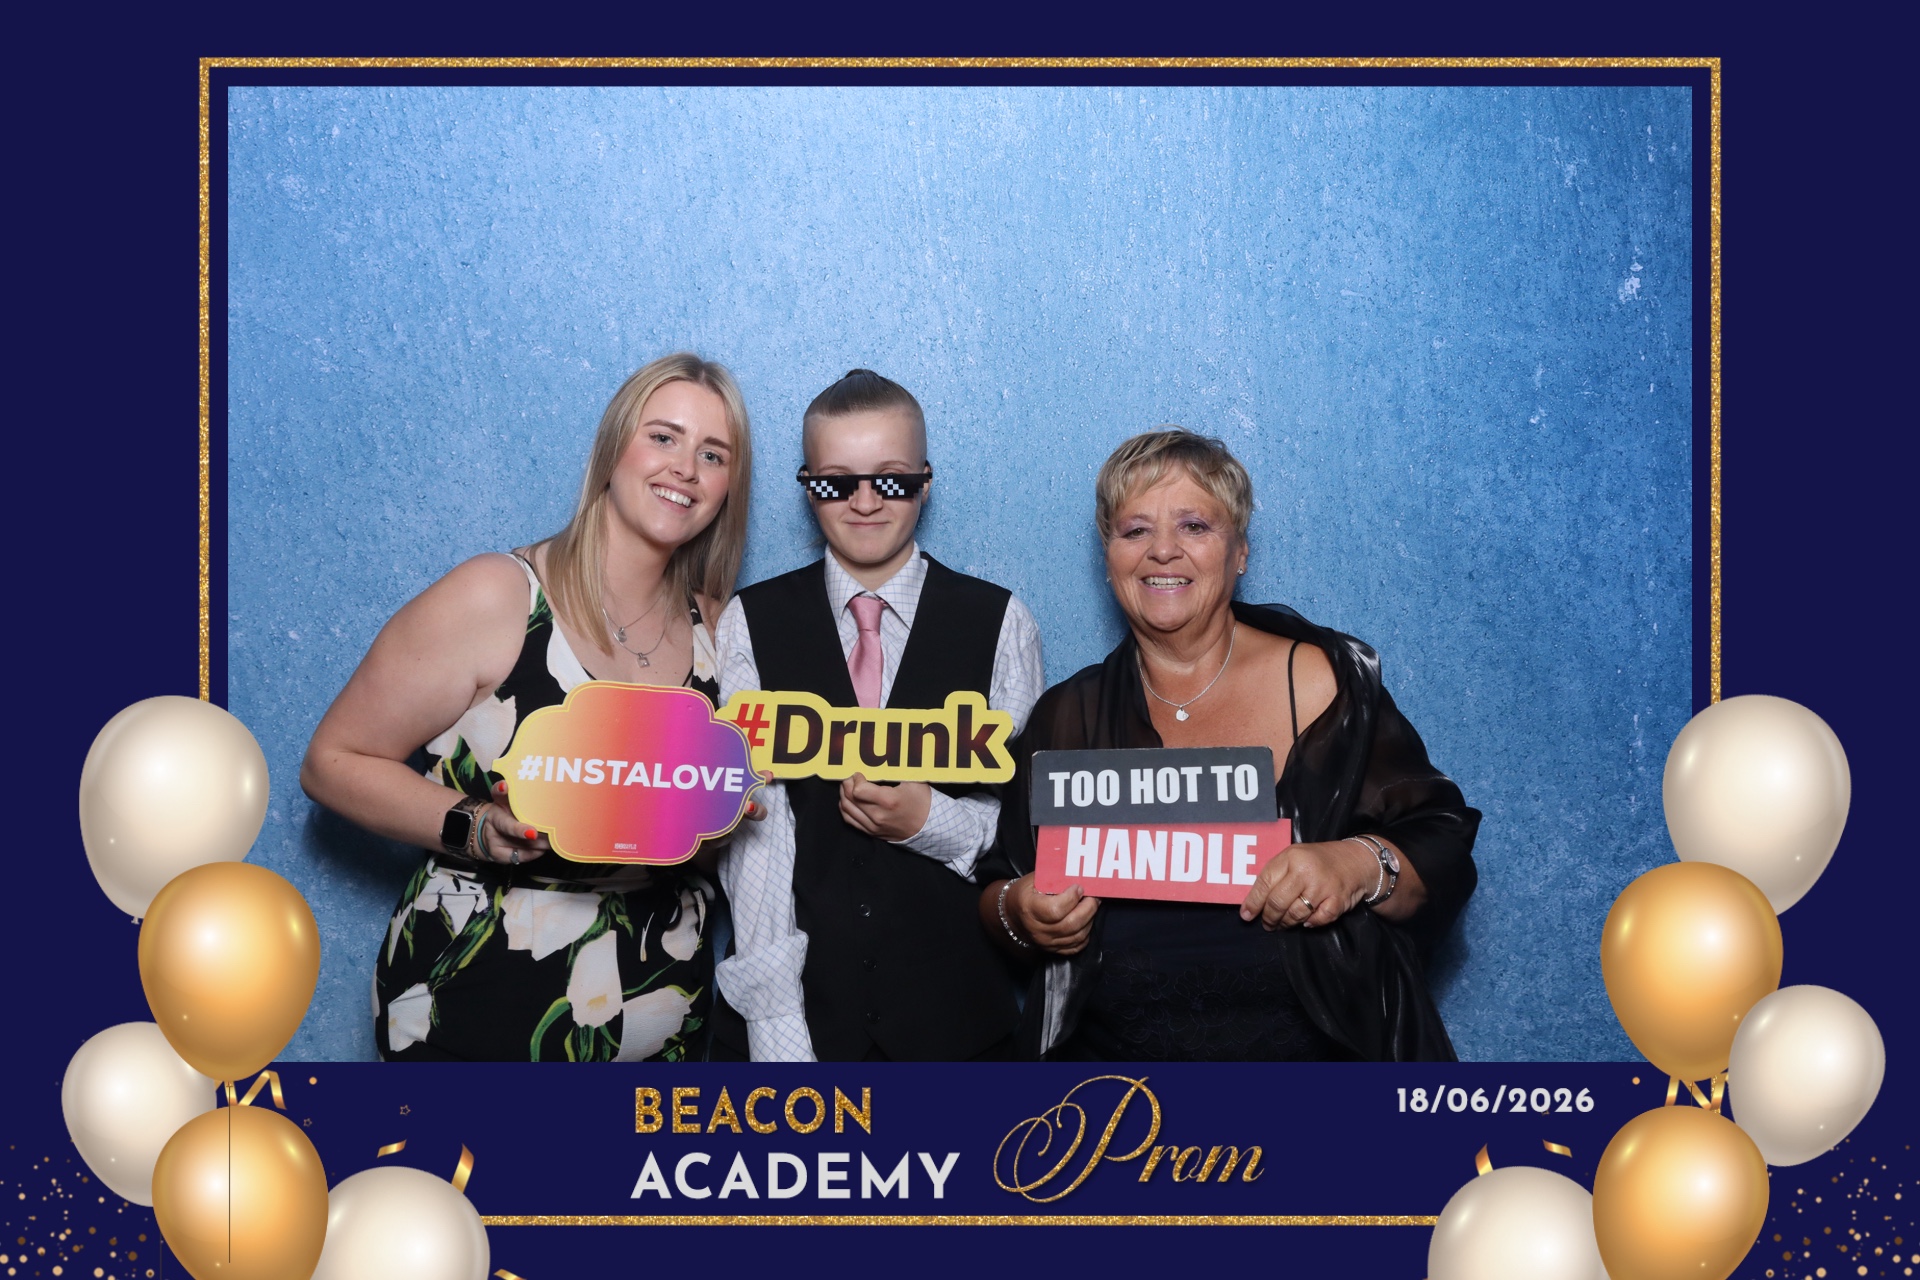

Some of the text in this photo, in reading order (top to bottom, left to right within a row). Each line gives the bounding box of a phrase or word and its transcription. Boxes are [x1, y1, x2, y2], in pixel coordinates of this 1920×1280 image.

[730, 702, 1001, 770] #Drunk
[517, 755, 745, 793] #INSTALOVE
[1049, 764, 1259, 808] TOO HOT TO
[1065, 826, 1258, 885] HANDLE
